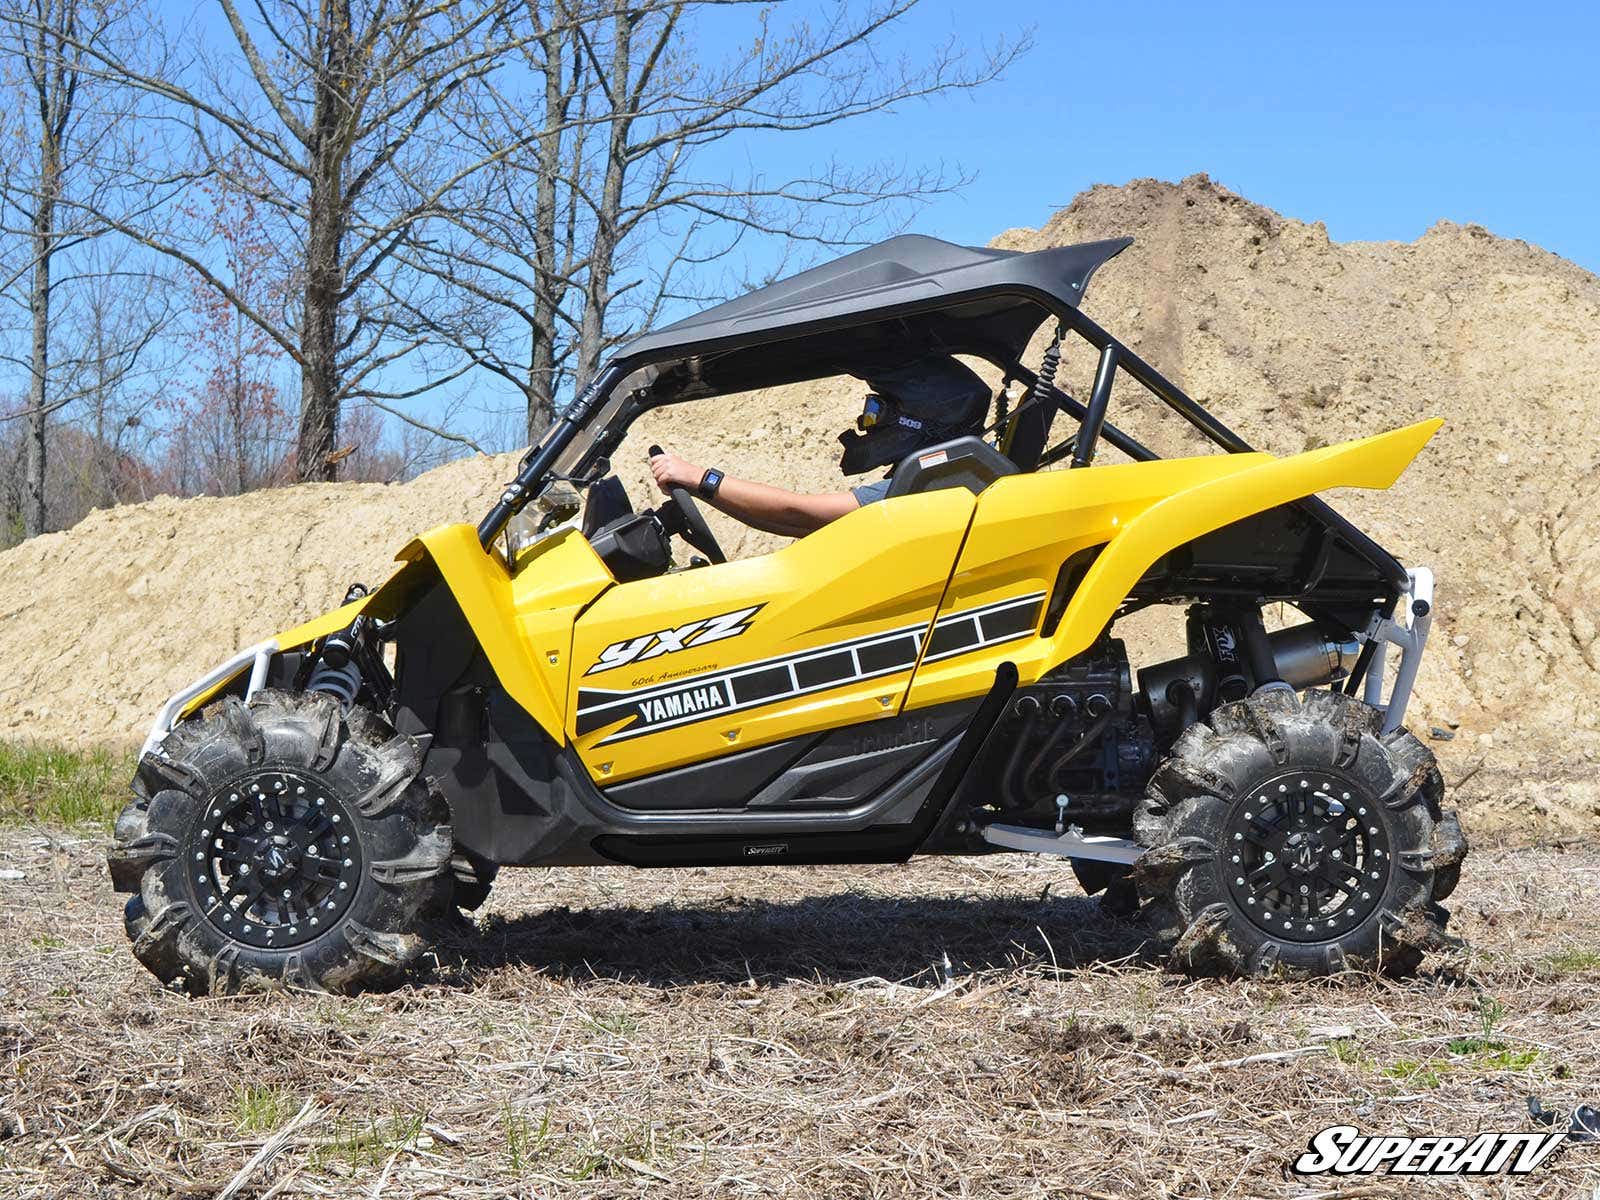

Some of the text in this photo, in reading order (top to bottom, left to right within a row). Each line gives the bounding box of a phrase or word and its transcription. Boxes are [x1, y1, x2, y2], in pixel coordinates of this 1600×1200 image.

[631, 663, 718, 687] 60th Anniversary
[638, 686, 724, 723] YAMAHA
